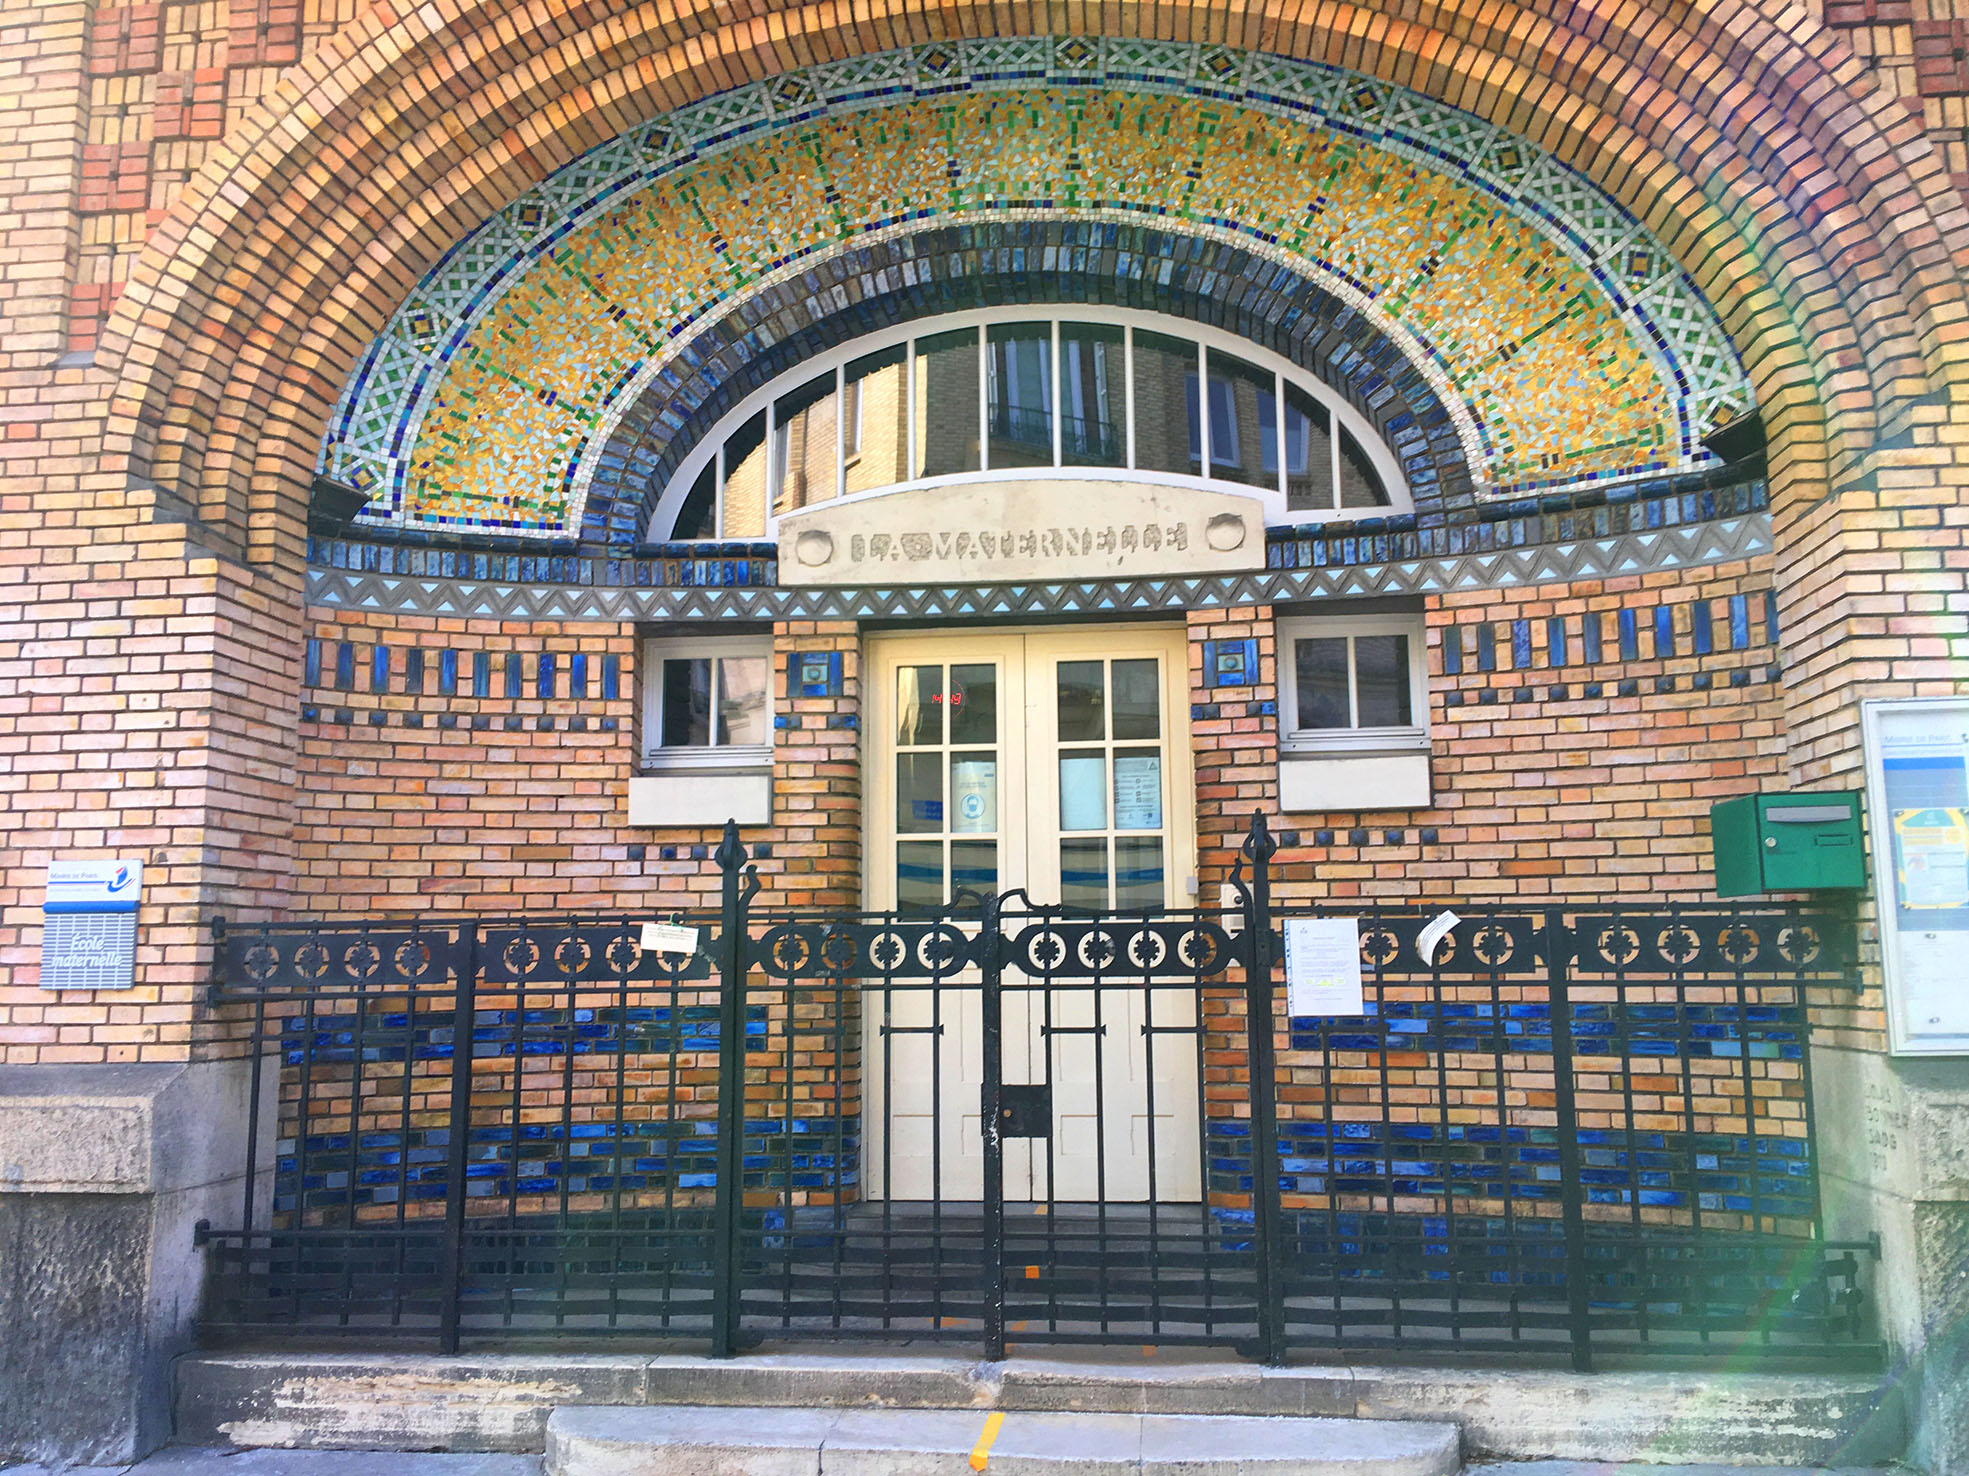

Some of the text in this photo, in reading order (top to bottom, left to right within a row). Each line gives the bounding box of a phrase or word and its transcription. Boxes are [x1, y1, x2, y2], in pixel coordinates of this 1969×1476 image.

[929, 521, 1188, 559] MATERNELLE
[70, 932, 105, 951] École
[50, 951, 122, 968] maternelle
